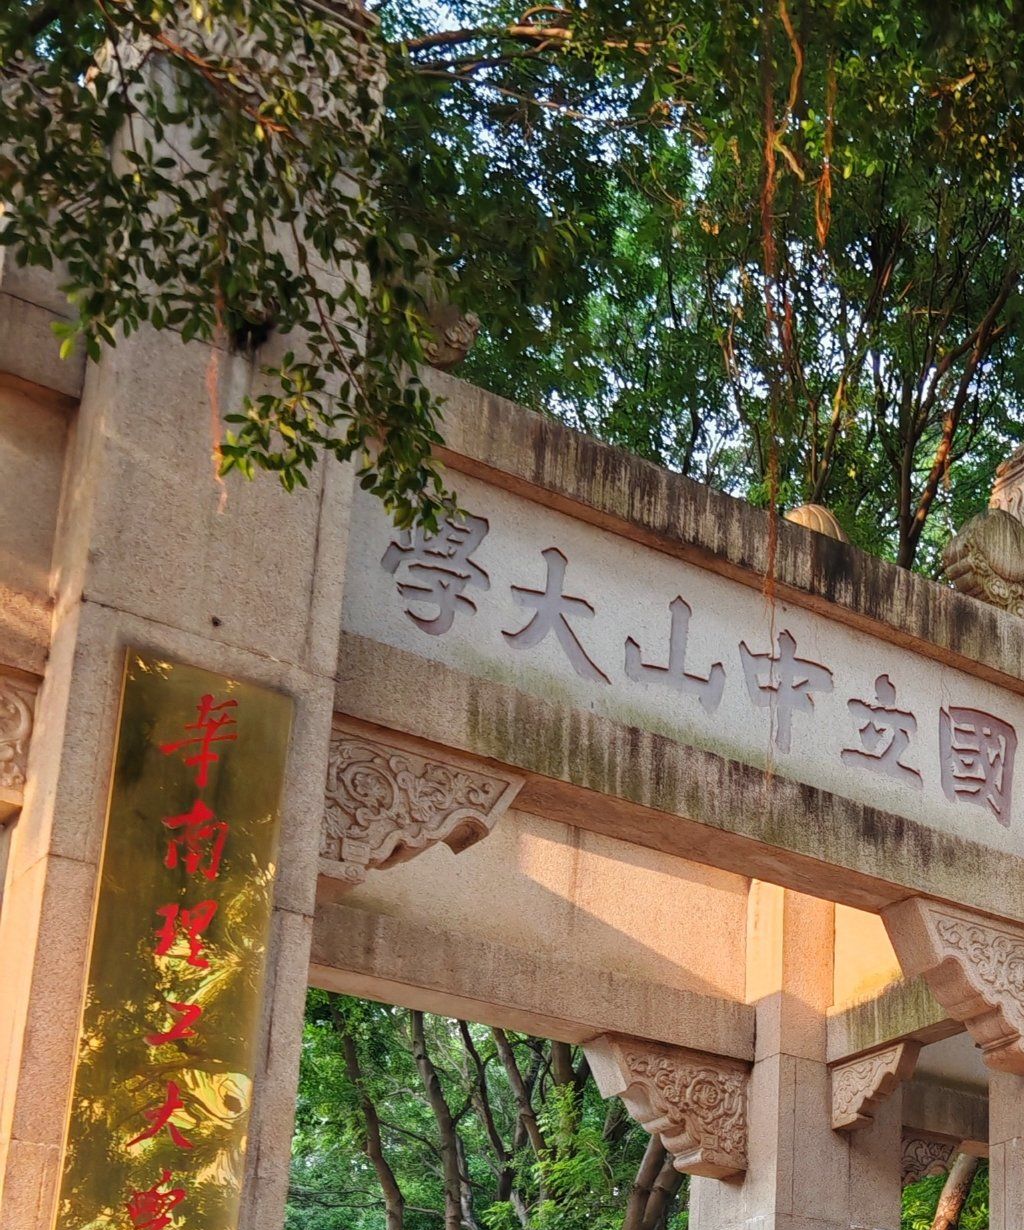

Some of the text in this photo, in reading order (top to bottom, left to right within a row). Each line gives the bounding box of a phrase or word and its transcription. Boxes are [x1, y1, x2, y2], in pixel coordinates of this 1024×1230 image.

[379, 512, 1019, 827] 國立中山大學
